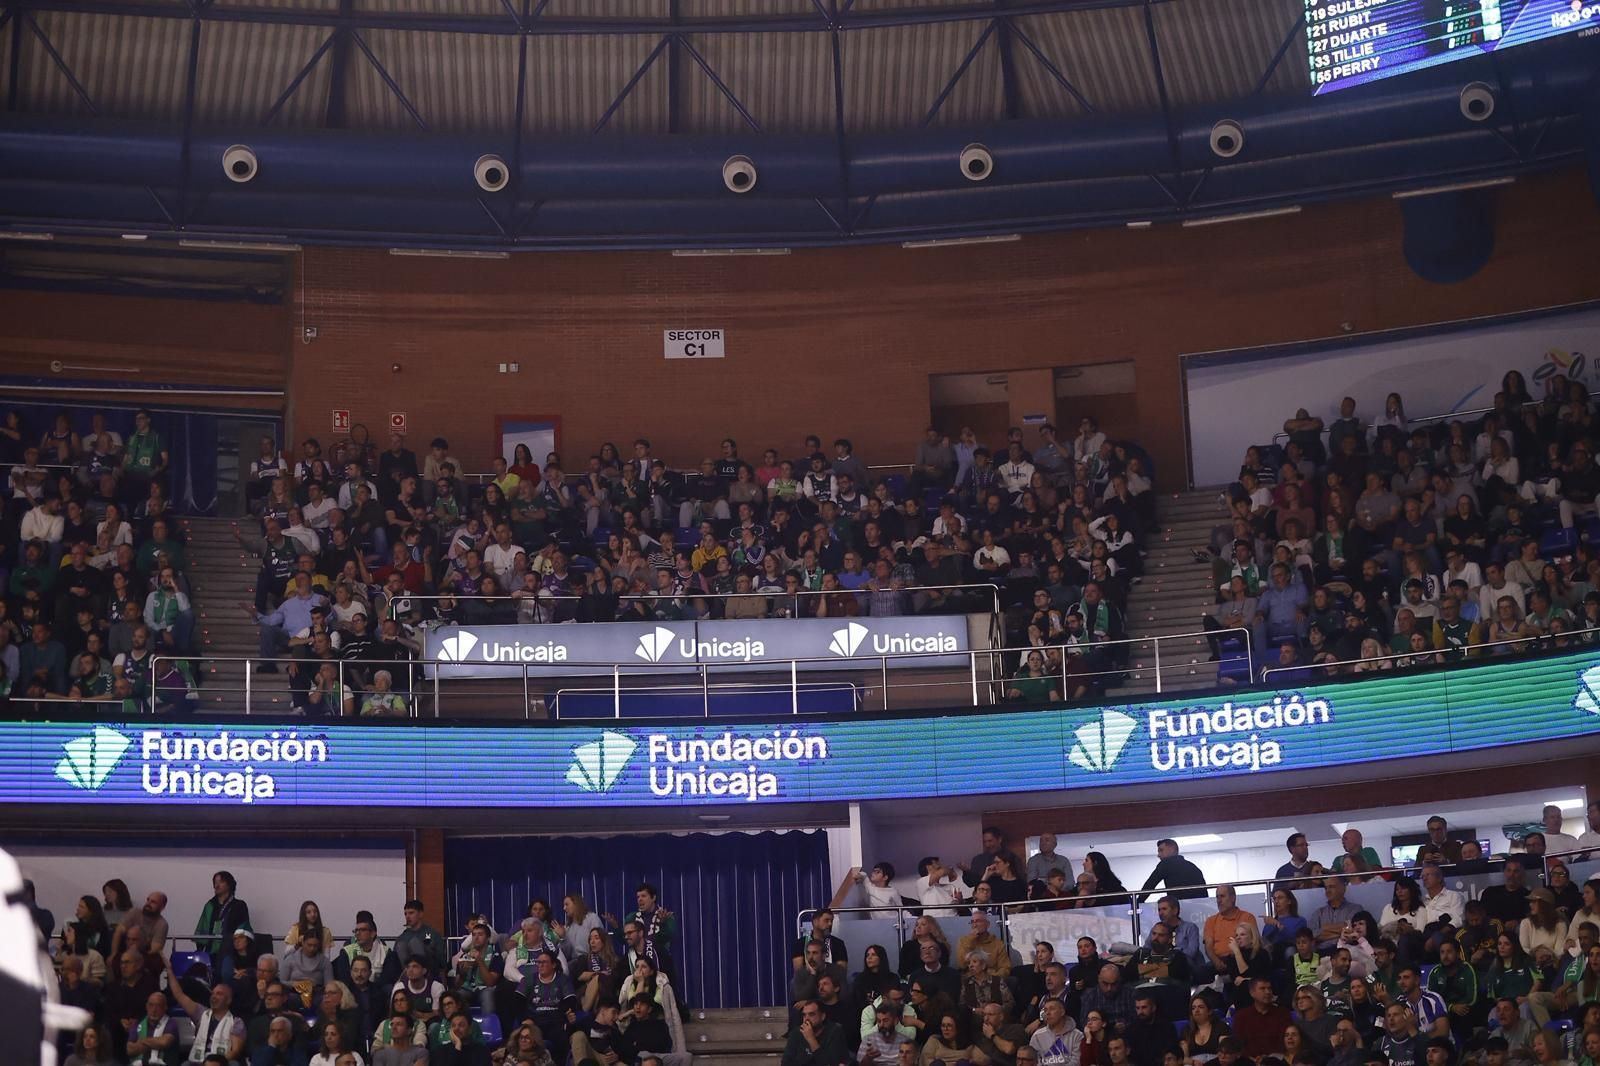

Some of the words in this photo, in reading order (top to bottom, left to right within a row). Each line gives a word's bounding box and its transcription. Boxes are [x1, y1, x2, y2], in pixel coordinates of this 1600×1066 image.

[1312, 8, 1326, 20] 19
[1312, 24, 1326, 37] 21
[1329, 11, 1371, 32] RUBIT
[1314, 39, 1328, 53] 27
[1330, 23, 1388, 48] DUARTE
[1315, 54, 1330, 68] 33
[1332, 42, 1374, 62] TILLIE
[1317, 70, 1331, 83] 55
[1332, 56, 1380, 79] PERRY
[668, 331, 720, 340] SECTOR
[684, 343, 705, 356] C1
[482, 640, 567, 663] Unicaja
[680, 636, 764, 661] Unicaja
[873, 631, 957, 654] Unicaja
[1149, 695, 1330, 738] Fundación
[140, 731, 327, 761] Fundación
[649, 730, 827, 762] Fundación
[1151, 734, 1282, 771] Unicaja
[141, 764, 276, 803] Unicaja
[650, 765, 778, 801] Unicaja
